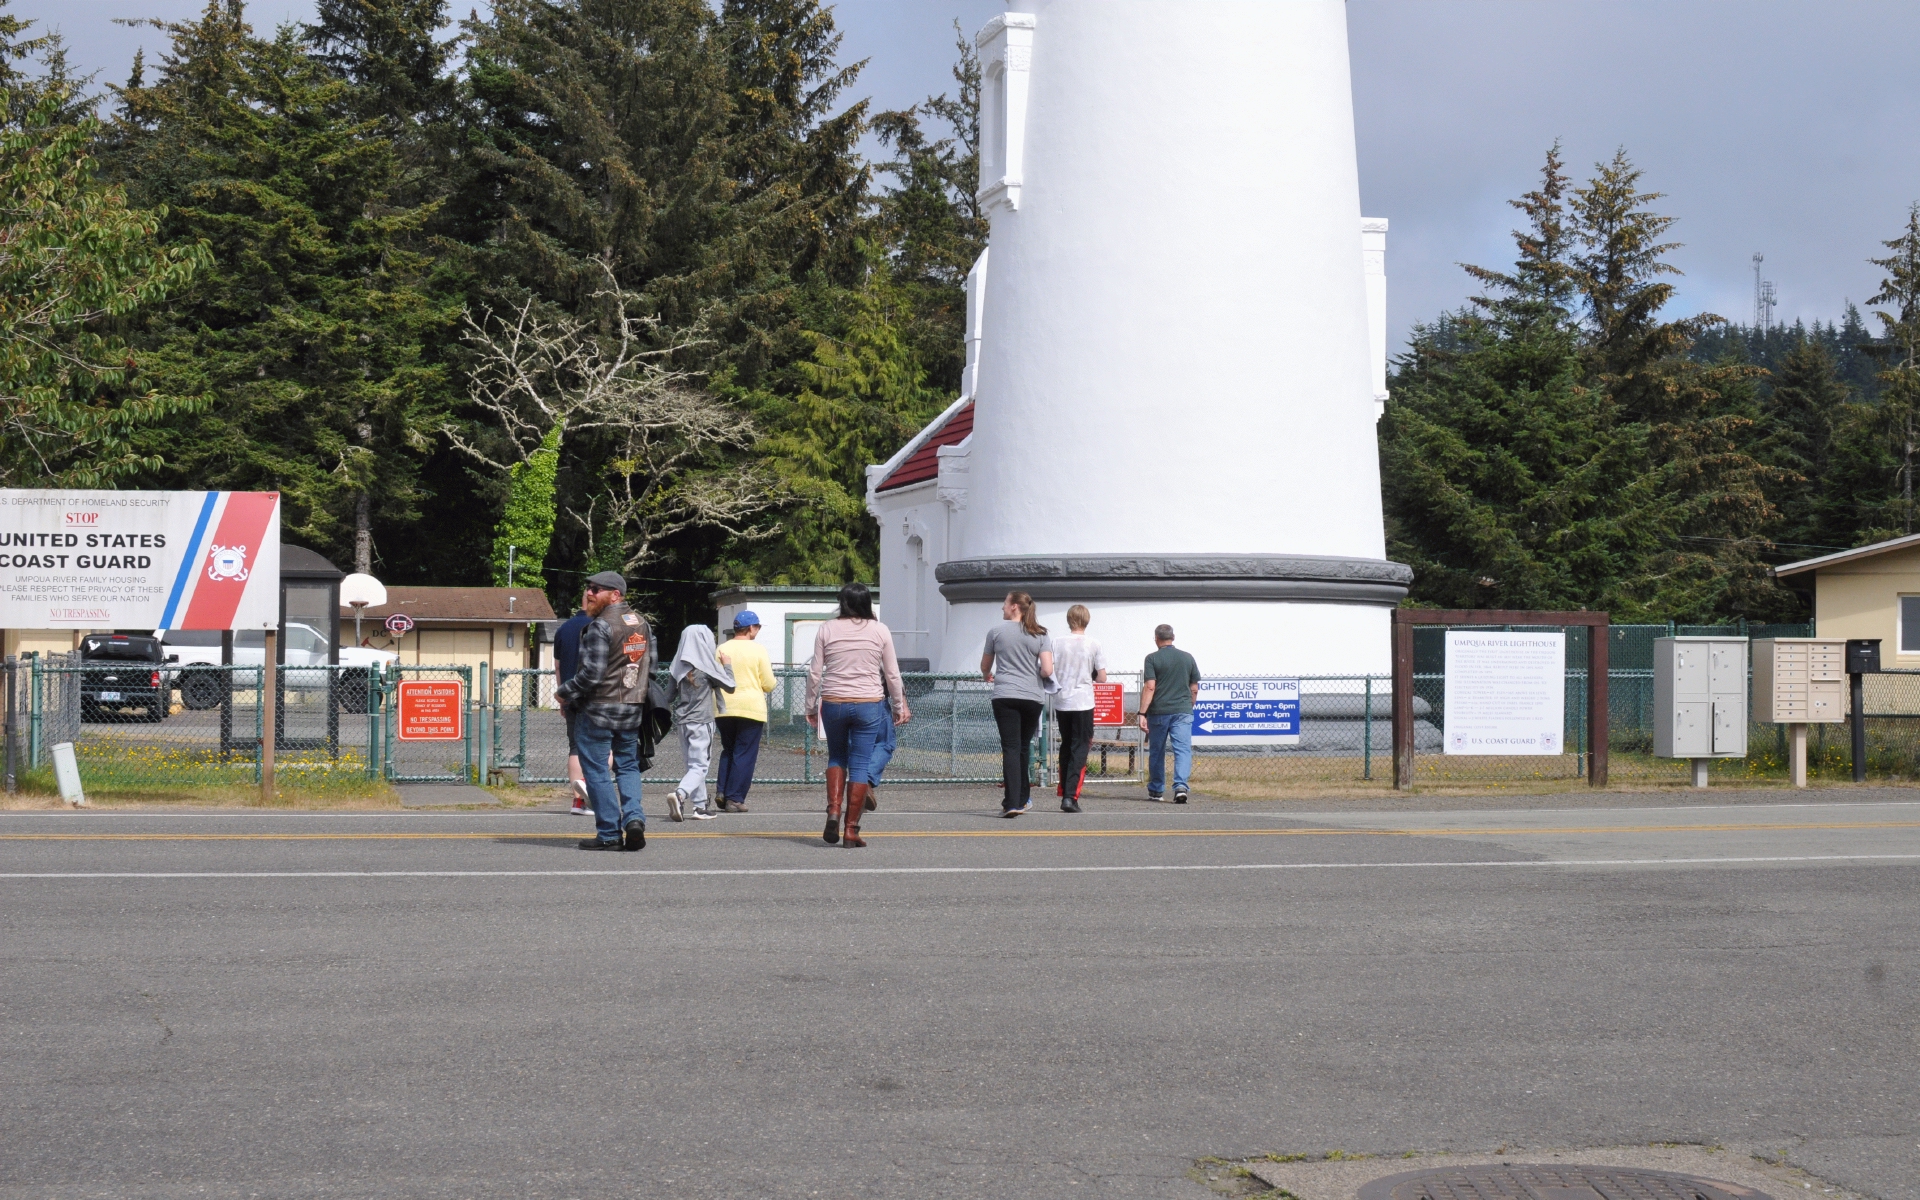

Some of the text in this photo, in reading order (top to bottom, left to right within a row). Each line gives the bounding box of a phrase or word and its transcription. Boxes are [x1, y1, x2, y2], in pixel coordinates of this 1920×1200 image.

[0, 497, 170, 507] .S. DEPARTMENT OF HOMELAND SECURITY
[66, 512, 99, 524] STOP
[0, 533, 166, 548] UNITED STATES
[0, 554, 150, 568] COAST GUARD
[16, 576, 50, 584] UMPQUA
[53, 576, 77, 584] RIVER
[79, 576, 107, 584] FAMILY
[50, 608, 110, 618] NO TRESPASSING
[372, 630, 387, 638] DC
[1198, 682, 1297, 690] IGHTHOUSE TOURS
[1230, 691, 1258, 700] DAILY
[1272, 711, 1290, 719] 4pm
